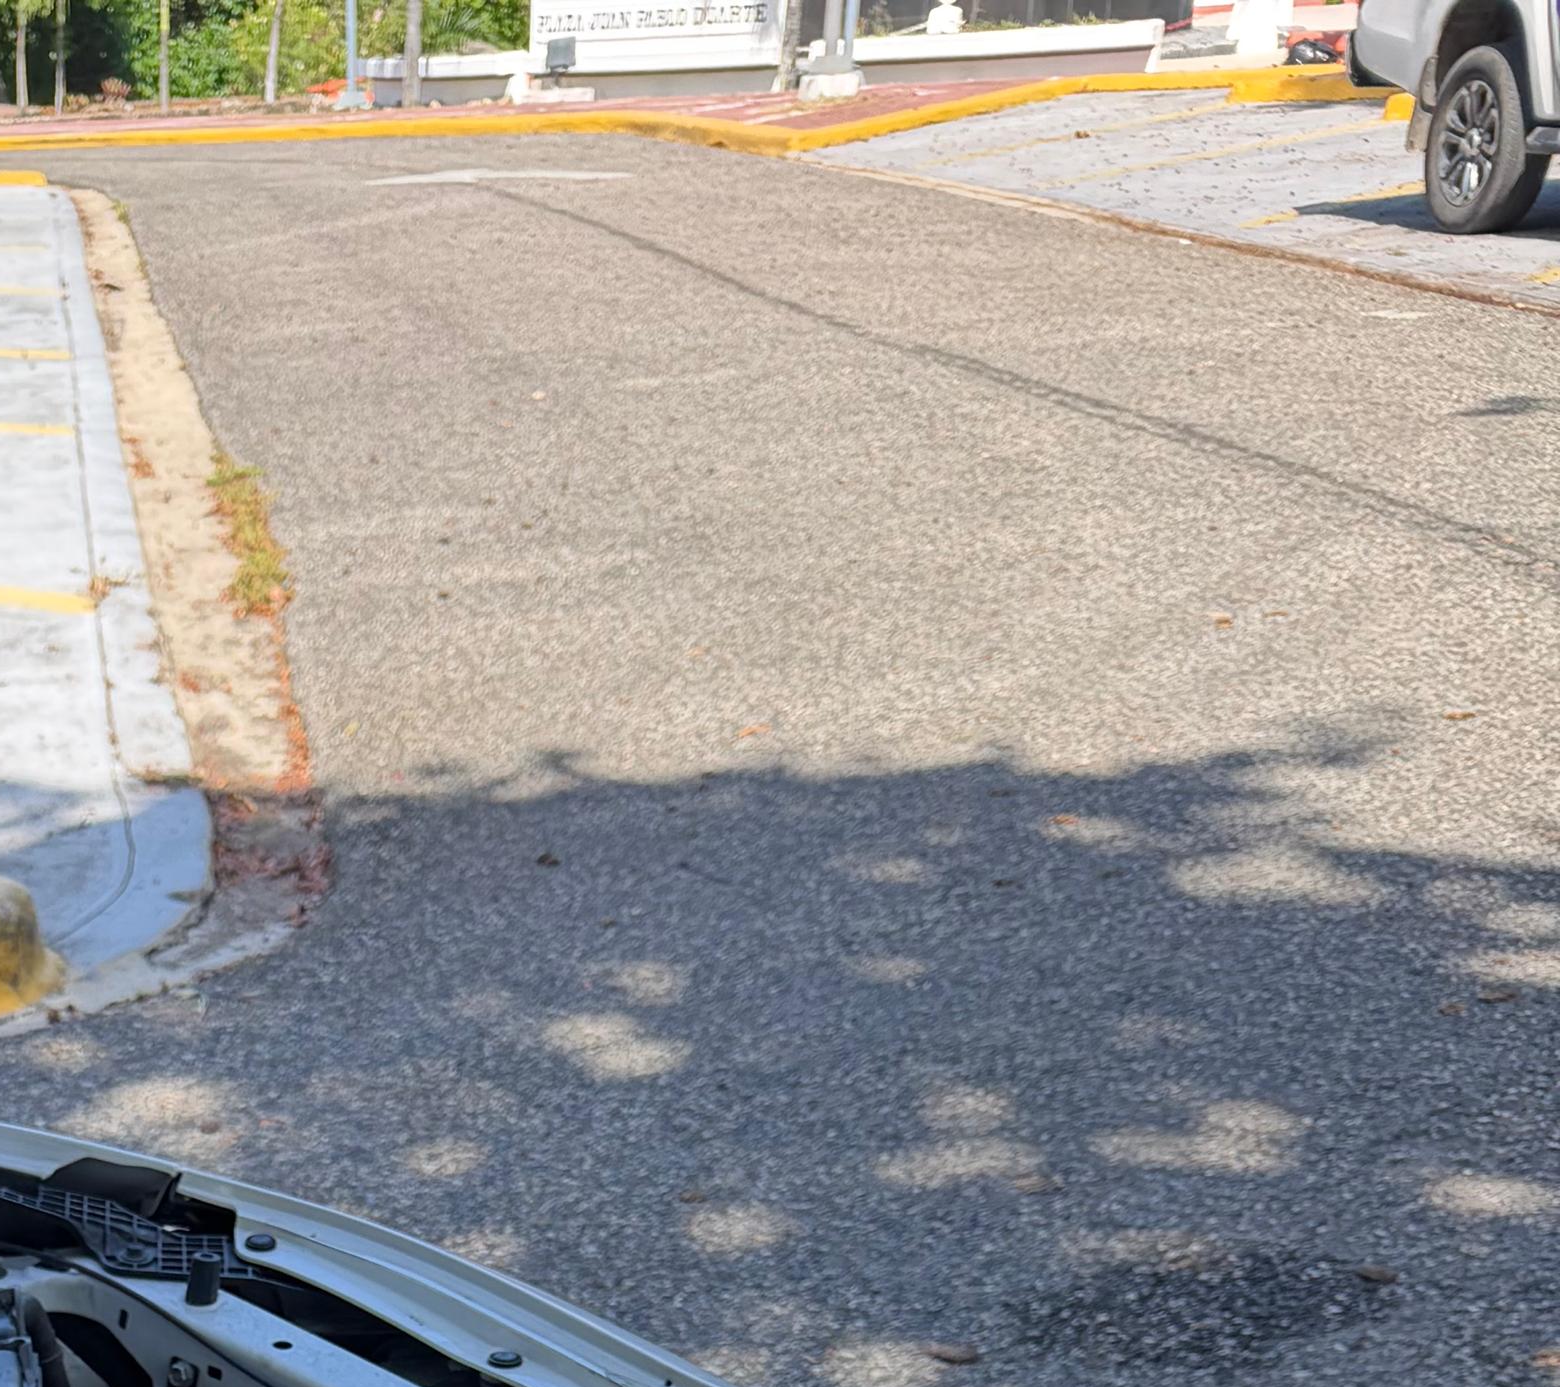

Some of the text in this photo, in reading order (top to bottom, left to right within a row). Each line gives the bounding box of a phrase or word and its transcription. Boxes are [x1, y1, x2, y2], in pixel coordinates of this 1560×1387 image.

[537, 15, 584, 33] PLAZA
[590, 12, 631, 30] JUAN
[693, 3, 768, 25] DUARTE
